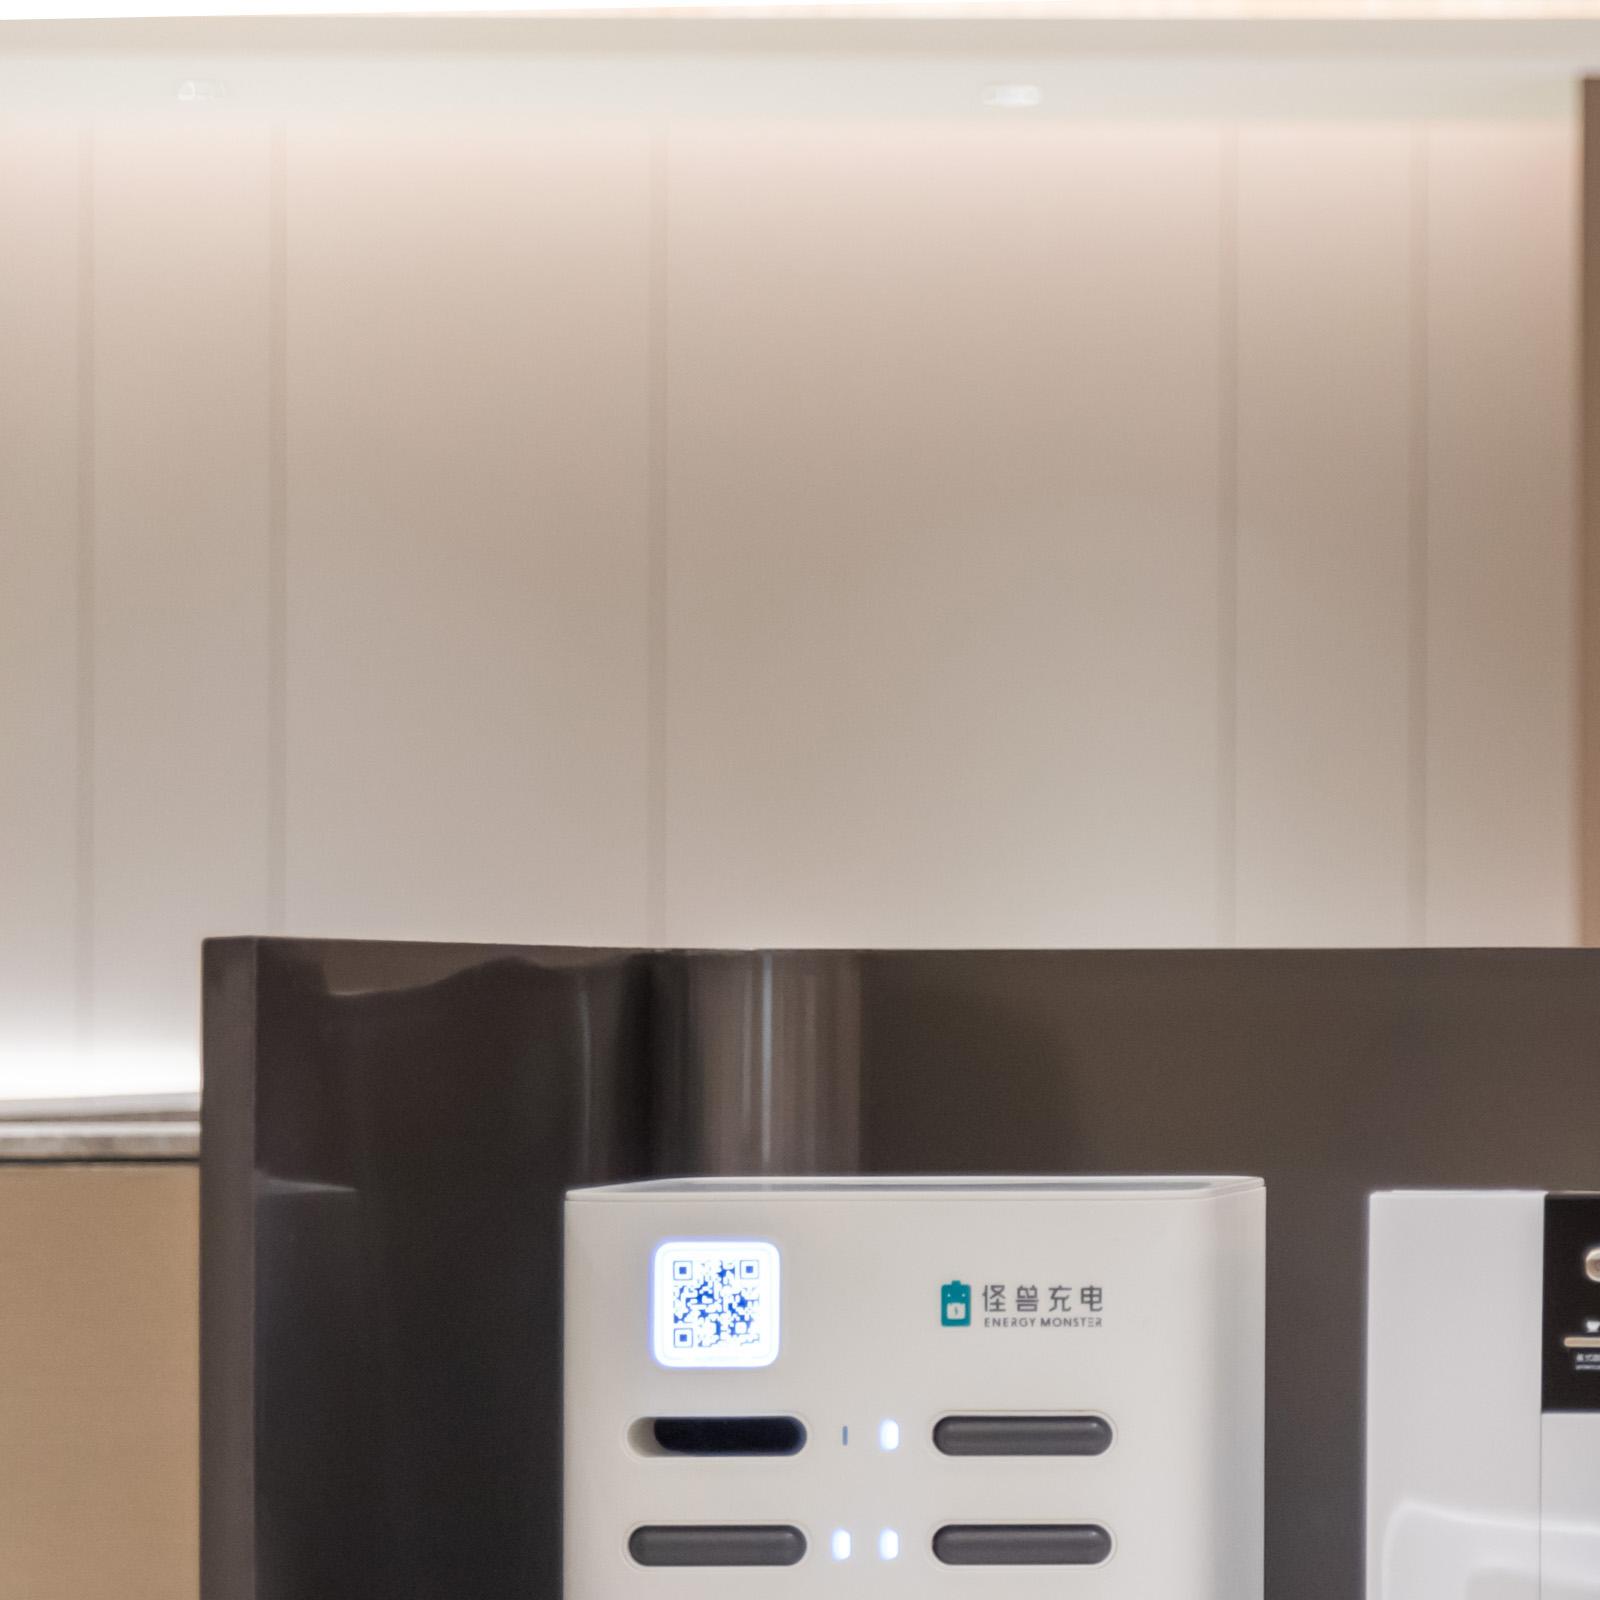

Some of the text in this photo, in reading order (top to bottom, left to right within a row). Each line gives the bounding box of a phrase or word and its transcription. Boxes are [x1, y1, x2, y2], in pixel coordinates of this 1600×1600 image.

[982, 1284, 1103, 1312] 怪兽充电
[984, 1317, 1103, 1328] ENERGY MONSTER
